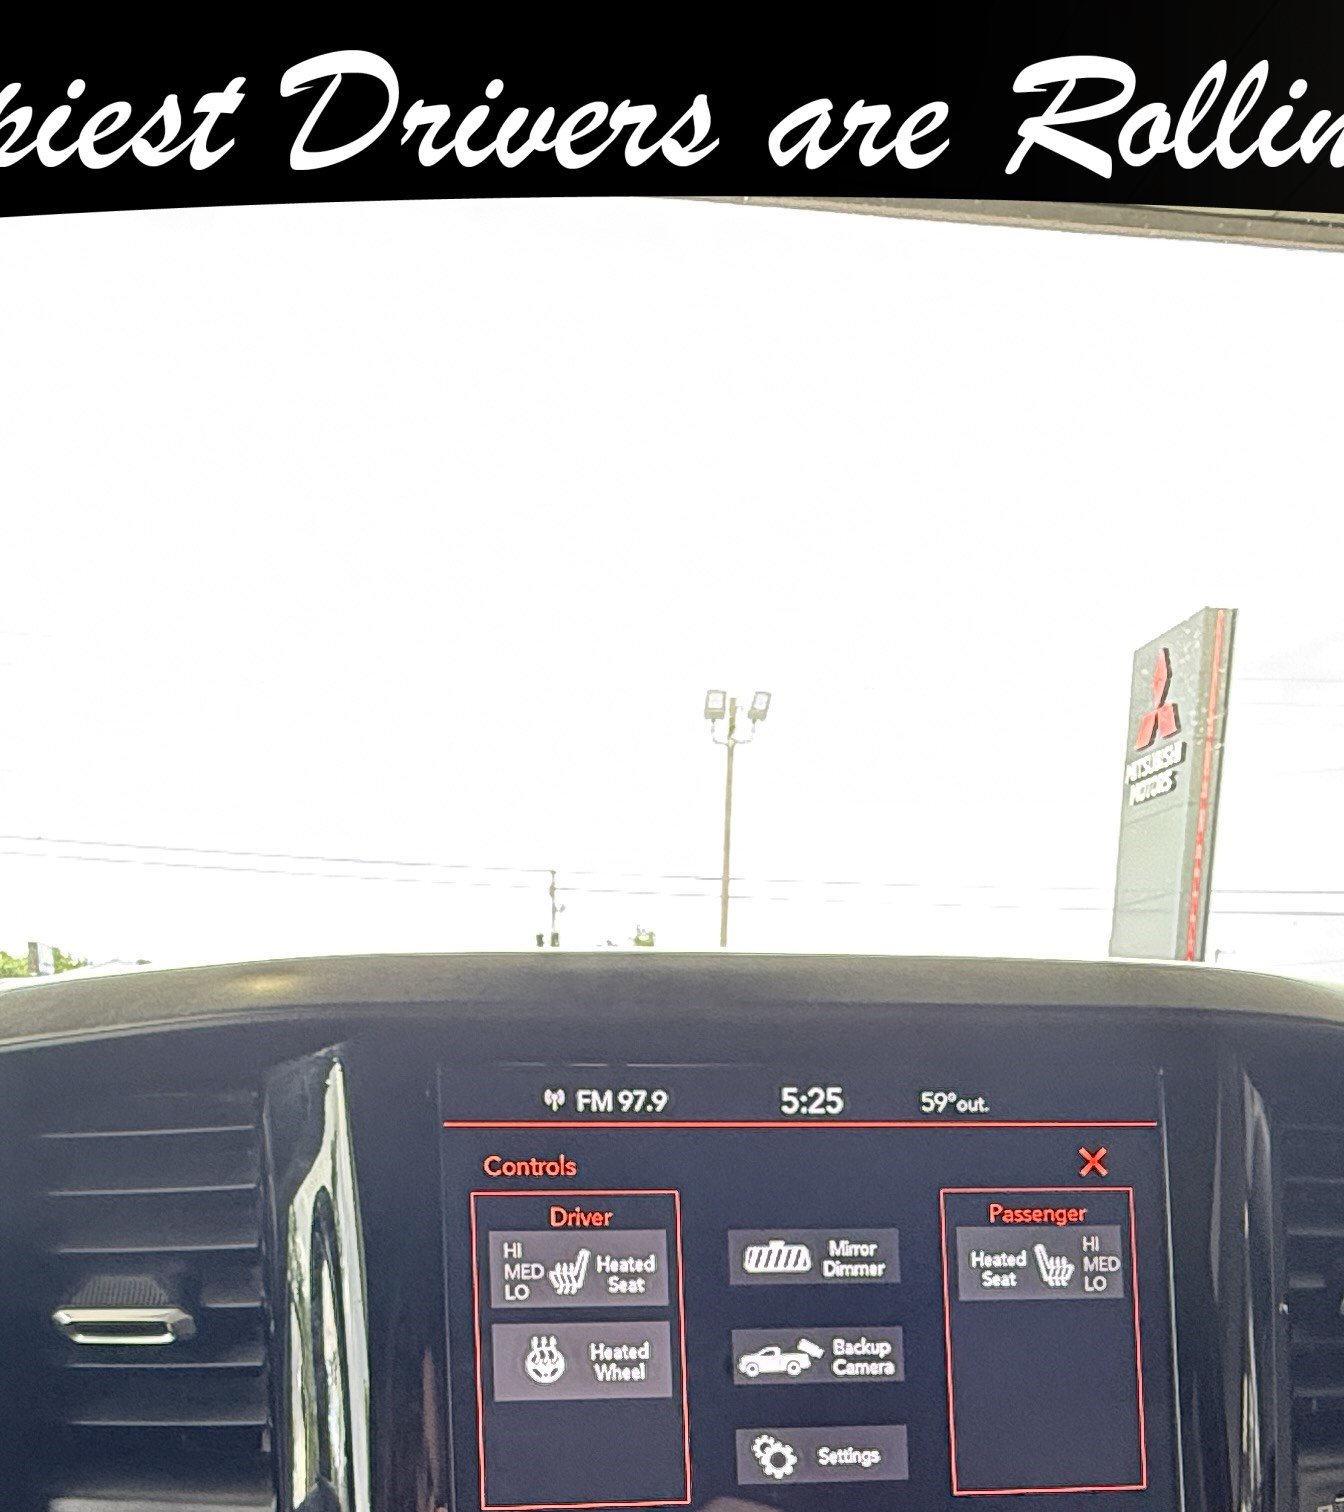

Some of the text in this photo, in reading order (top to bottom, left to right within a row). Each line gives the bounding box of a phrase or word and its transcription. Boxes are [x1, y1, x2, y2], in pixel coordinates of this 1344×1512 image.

[575, 1089, 668, 1113] FM 97.9
[780, 1087, 845, 1115] 5:25
[483, 1154, 577, 1177] Controls
[550, 1206, 613, 1227] Driver
[989, 1203, 1087, 1226] Passenger
[503, 1242, 522, 1258] HI
[828, 1240, 878, 1257] Mirror
[1082, 1235, 1100, 1252] HI
[596, 1254, 656, 1273] Heated
[970, 1250, 1027, 1268] Heated
[1083, 1256, 1121, 1272] MED
[504, 1264, 544, 1280] MED
[823, 1260, 886, 1277] Dimmer
[607, 1277, 646, 1294] Seat
[982, 1270, 1018, 1287] Seat
[1084, 1276, 1107, 1292] LO
[505, 1284, 530, 1301] LO
[589, 1341, 650, 1361] Heated
[832, 1337, 892, 1359] Backup
[593, 1363, 646, 1381] Wheel
[832, 1358, 896, 1376] Camera
[817, 1446, 881, 1467] Settings
